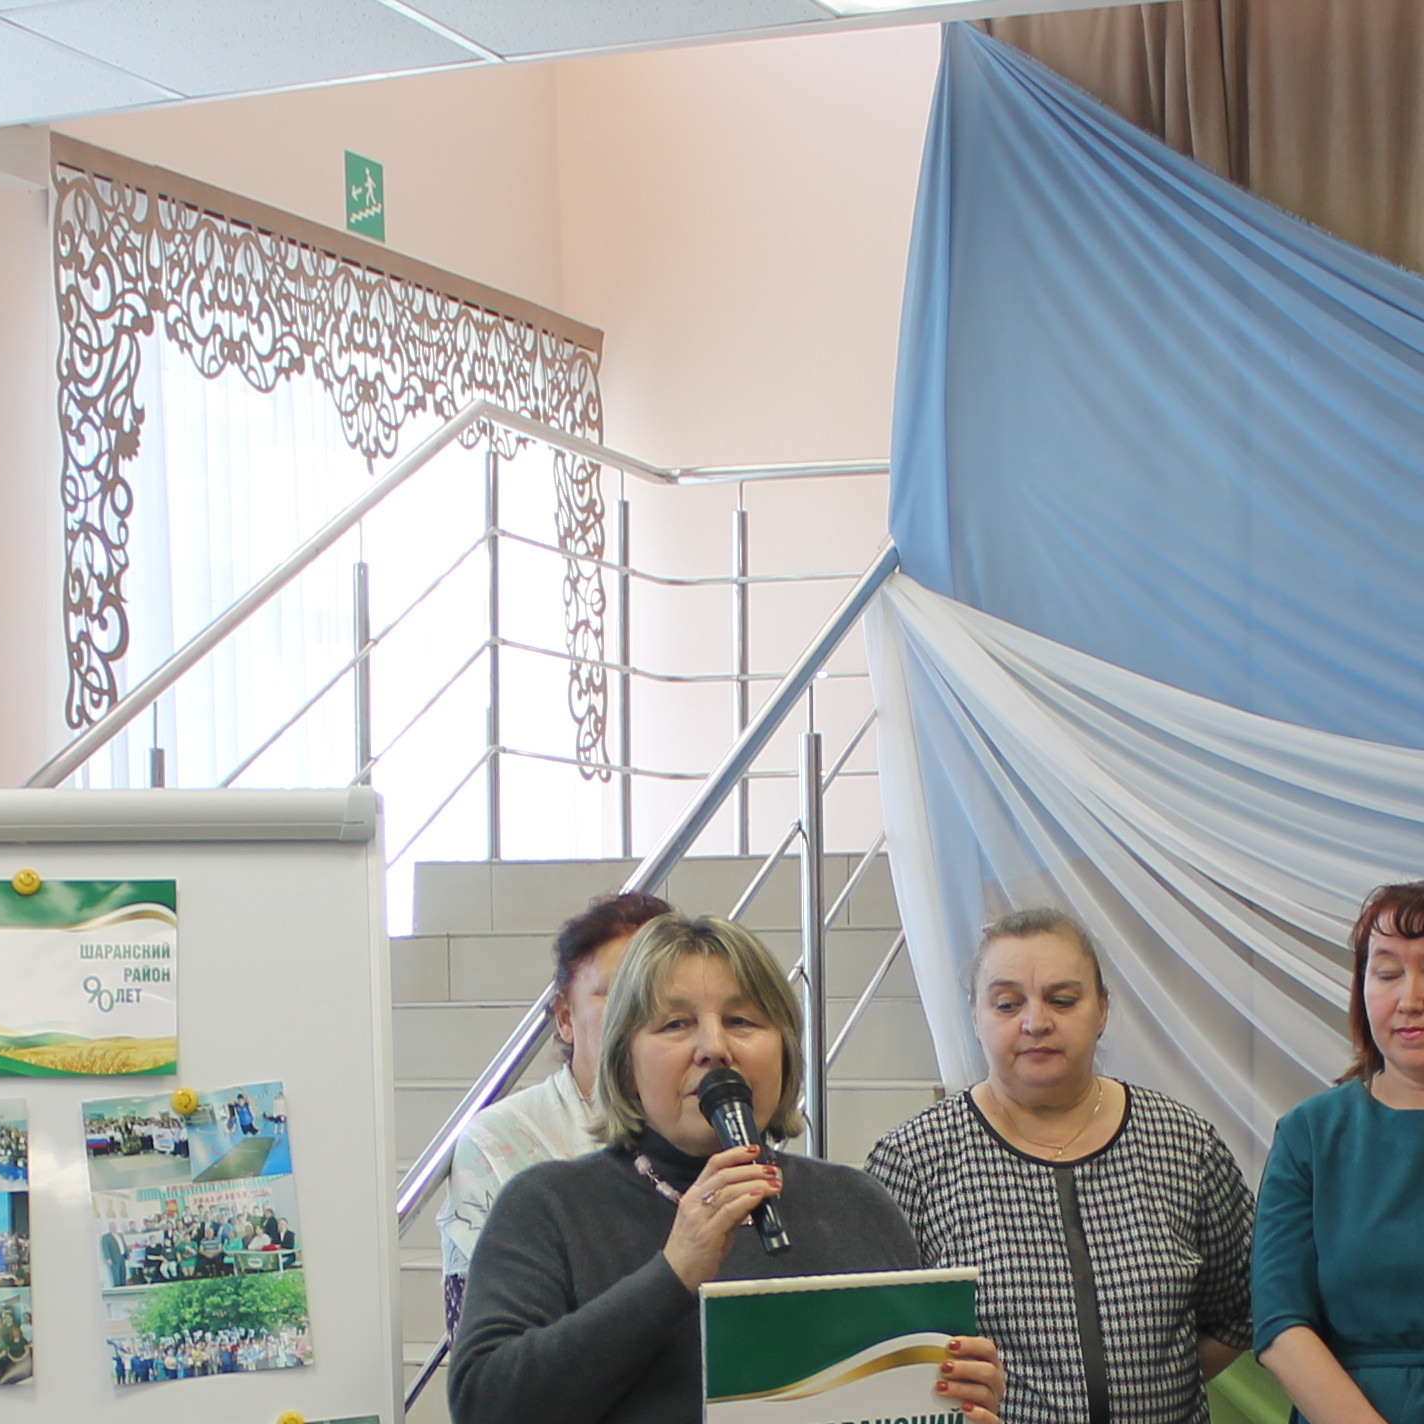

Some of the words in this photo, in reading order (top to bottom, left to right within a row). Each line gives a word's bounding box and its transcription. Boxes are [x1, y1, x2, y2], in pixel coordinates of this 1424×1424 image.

[79, 942, 171, 960] ШАРАНСКИЙ
[122, 964, 171, 983] РАЙОН
[82, 975, 115, 1013] 90
[115, 987, 143, 1003] ЛЕТ
